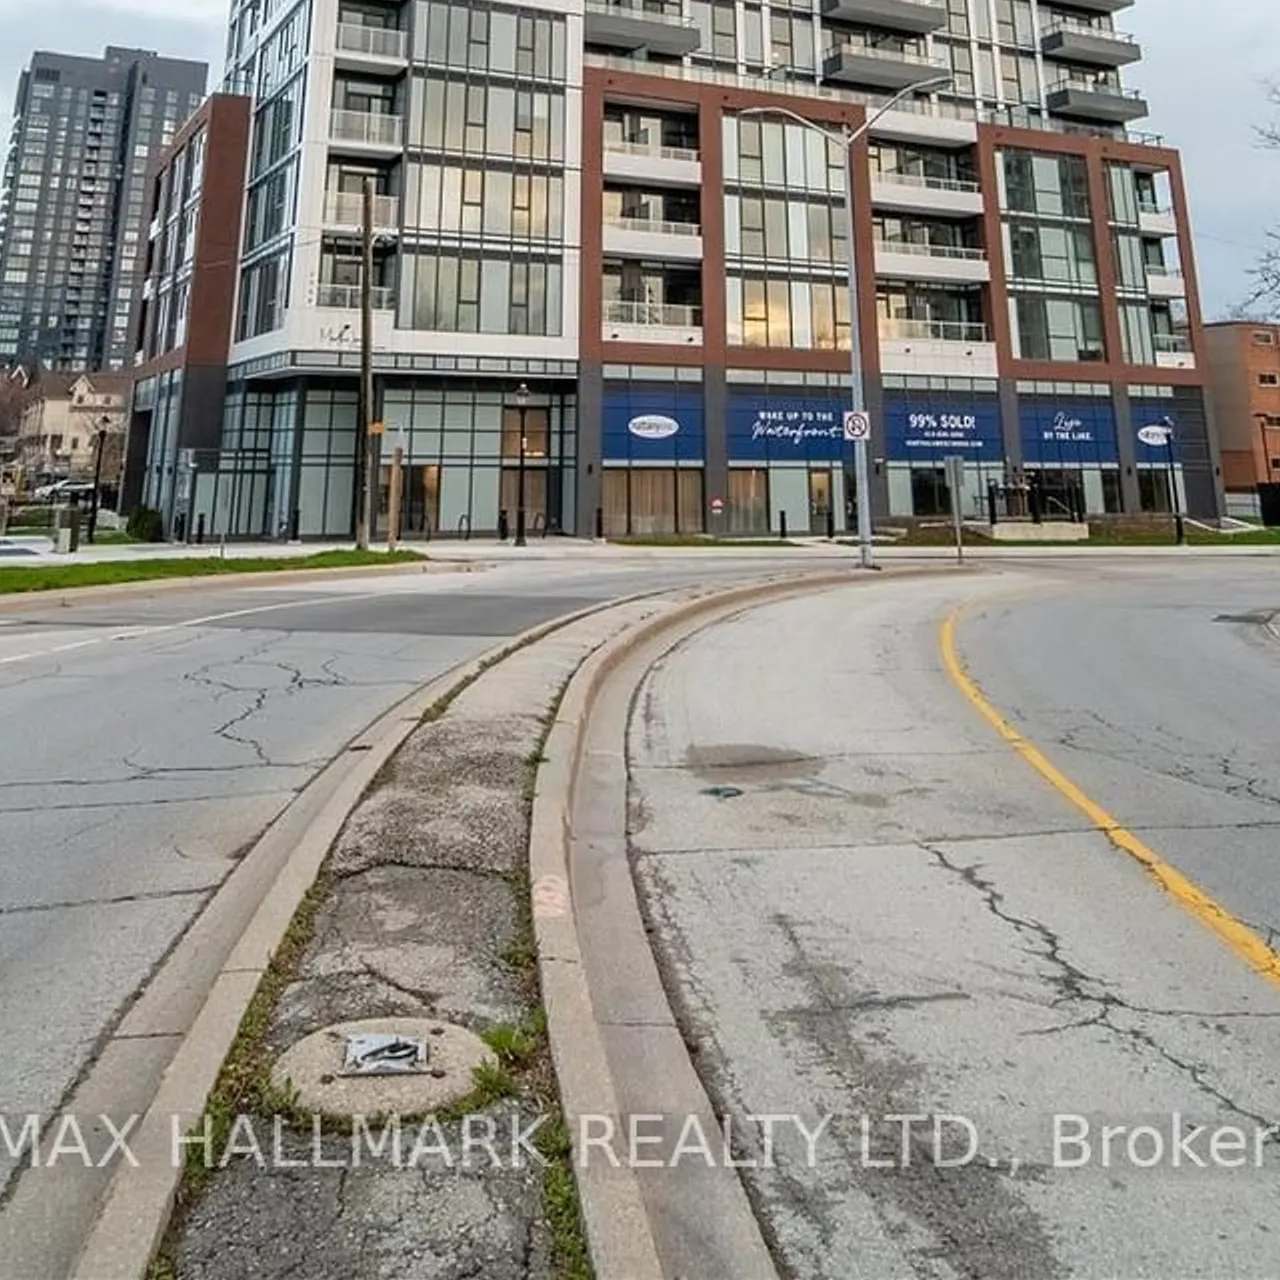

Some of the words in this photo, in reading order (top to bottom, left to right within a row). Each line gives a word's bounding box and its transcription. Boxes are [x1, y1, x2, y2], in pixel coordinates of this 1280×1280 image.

[759, 411, 783, 420] WAKE
[786, 411, 799, 421] UP
[802, 412, 814, 421] TO
[816, 412, 833, 421] THE
[909, 414, 937, 428] 99%
[940, 414, 976, 429] SOLD!
[1056, 431, 1070, 440] THE
